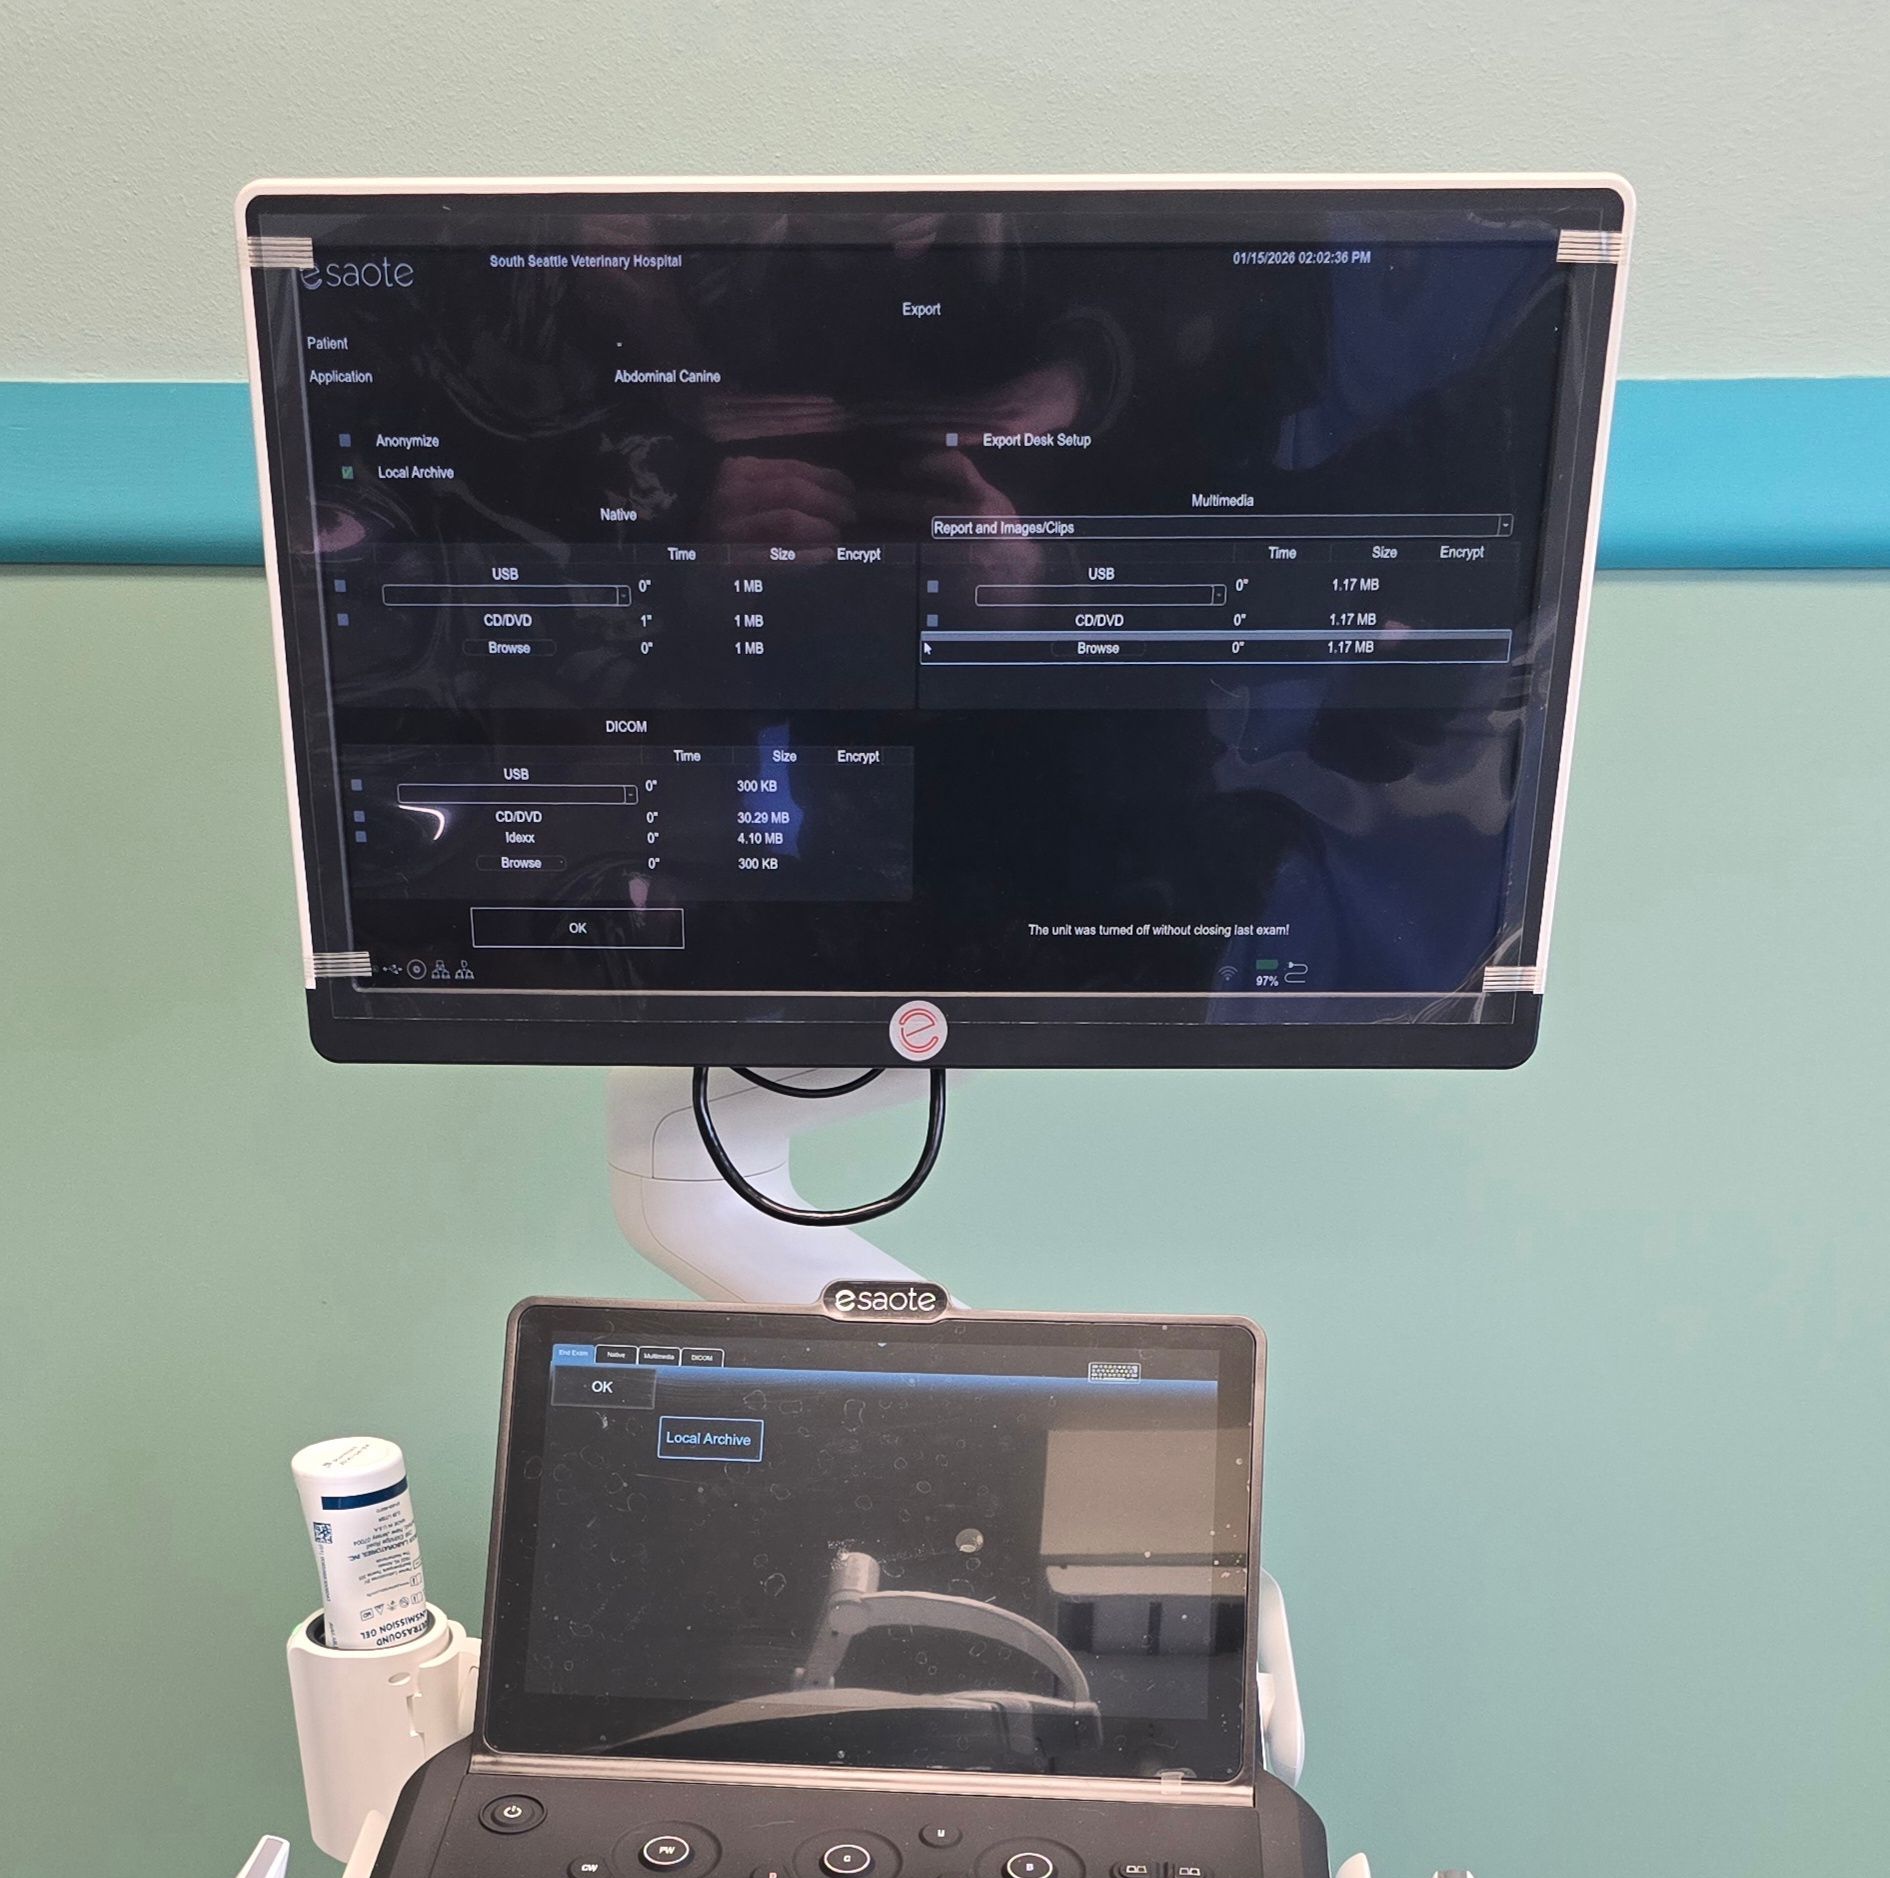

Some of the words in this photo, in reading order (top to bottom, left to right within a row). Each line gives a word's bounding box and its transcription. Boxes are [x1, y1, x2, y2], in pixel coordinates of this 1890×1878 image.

[490, 255, 524, 267] South
[528, 255, 568, 267] Seattle
[571, 255, 630, 270] Veterinary
[634, 255, 681, 270] Hospital
[1233, 252, 1295, 264] 01/15/2026
[1299, 251, 1348, 263] 02:02:36
[1352, 251, 1371, 263] PM
[300, 256, 414, 289] esaote
[903, 302, 941, 318] Export
[307, 337, 348, 349] Patient
[310, 370, 372, 385] Application
[615, 370, 676, 382] Abdominal
[679, 369, 720, 382] Canine
[376, 434, 439, 450] Anonymize
[984, 433, 1021, 448] Export
[1024, 433, 1053, 446] Desk
[1057, 433, 1091, 448] Setup
[379, 466, 409, 478] Local
[412, 466, 454, 479] Archive
[1192, 494, 1254, 506] Multimedia
[601, 508, 637, 521] Native
[935, 521, 972, 536] Report
[976, 521, 997, 534] and
[1001, 521, 1074, 536] Images/Clips
[668, 547, 696, 560] Time
[770, 548, 795, 560] Size
[837, 548, 881, 563] Encrypt
[1269, 546, 1296, 559] Time
[1372, 546, 1397, 558] Size
[1440, 546, 1484, 561] Encrypt
[492, 568, 518, 580] USB
[1089, 568, 1114, 580] USB
[735, 580, 739, 592] 1
[744, 580, 763, 592] MB
[1333, 578, 1357, 591] 1.17
[1360, 578, 1379, 590] MB
[484, 614, 532, 626] CD/DVD
[735, 615, 740, 627] 1
[745, 615, 763, 627] MB
[1076, 614, 1123, 626] CD/DVD
[1330, 613, 1354, 625] 1.17
[1357, 613, 1376, 625] MB
[489, 641, 530, 654] Browse
[736, 642, 740, 654] 1
[745, 642, 764, 654] MB
[1078, 642, 1119, 654] Browse
[1328, 641, 1352, 653] 1.17
[1355, 641, 1373, 653] MB
[606, 721, 647, 732] DICOM
[674, 750, 701, 761] Time
[773, 750, 796, 762] Size
[838, 750, 879, 764] Encrypt
[504, 768, 529, 780] USB
[738, 780, 758, 792] 300
[761, 780, 777, 792] KB
[496, 811, 542, 822] CD/DVD
[738, 812, 768, 823] 30.29
[771, 812, 790, 823] MB
[506, 832, 535, 843] Idexx
[738, 833, 762, 844] 4.10
[765, 833, 783, 844] MB
[502, 857, 541, 868] Browse
[739, 858, 759, 869] 300
[762, 858, 778, 869] KB
[569, 923, 587, 933] OK
[1028, 924, 1049, 935] The
[1052, 924, 1071, 935] unit
[1075, 927, 1096, 935] was
[1099, 925, 1133, 935] turned
[1136, 924, 1150, 935] off
[1152, 925, 1191, 935] without
[1194, 925, 1231, 937] closing
[1234, 925, 1253, 935] last
[1256, 924, 1289, 935] exam!
[1256, 976, 1278, 986] 97%
[834, 1289, 936, 1312] esaote
[607, 1351, 626, 1359] Native
[643, 1352, 675, 1361] Multimedia
[691, 1354, 713, 1362] DICOM
[591, 1380, 613, 1394] OK
[667, 1432, 700, 1444] Local
[703, 1433, 751, 1445] Archive
[379, 1610, 427, 1631] NSMISSION
[360, 1628, 377, 1639] GEL
